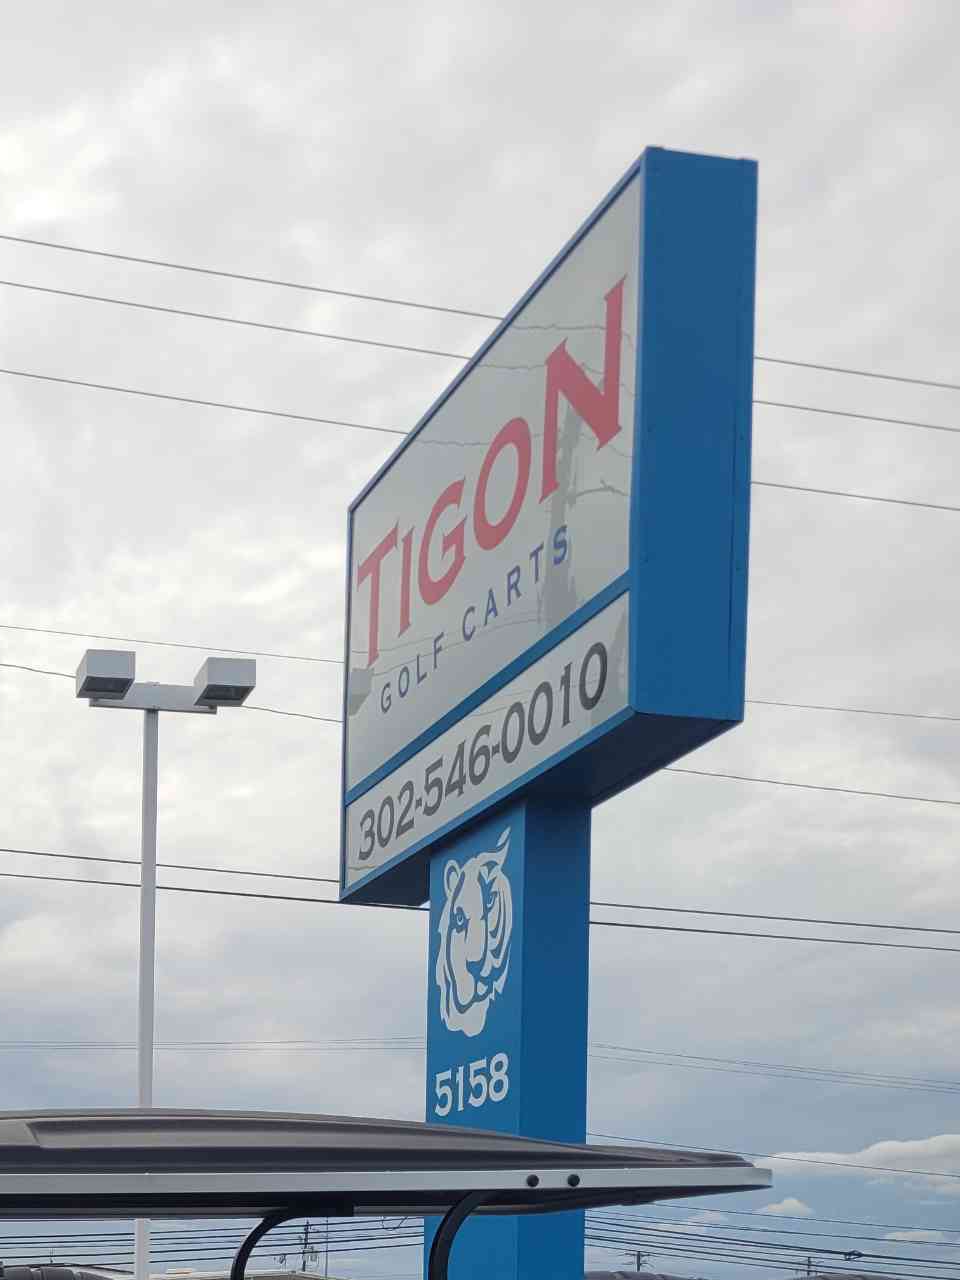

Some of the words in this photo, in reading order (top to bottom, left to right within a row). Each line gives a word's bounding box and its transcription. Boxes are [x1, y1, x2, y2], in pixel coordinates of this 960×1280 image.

[357, 273, 627, 668] TIGON
[380, 632, 445, 714] GOLF
[462, 525, 568, 642] CARTS
[358, 642, 608, 861] 302-546-0010
[434, 1052, 509, 1117] 5158
